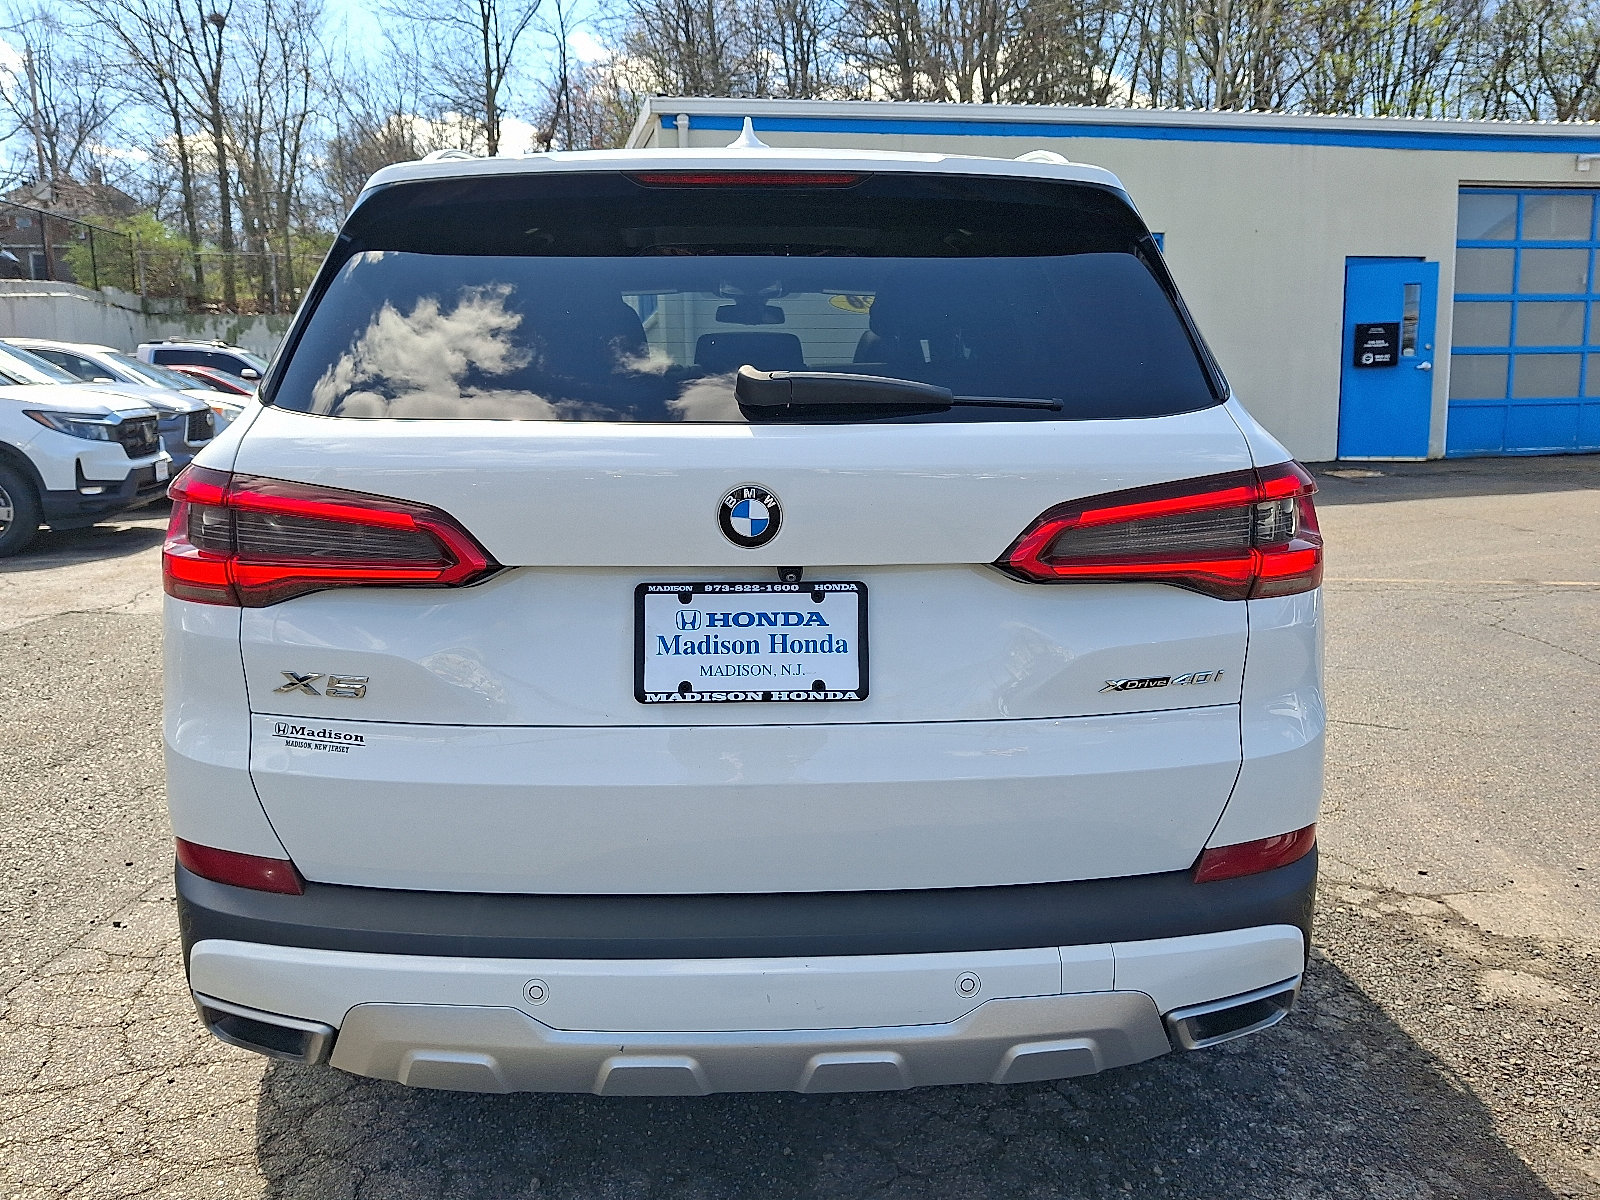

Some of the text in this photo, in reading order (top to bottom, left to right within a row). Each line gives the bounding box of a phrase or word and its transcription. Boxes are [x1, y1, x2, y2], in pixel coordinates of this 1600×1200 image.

[724, 488, 777, 509] BMW
[704, 584, 800, 592] 973-822-1600
[813, 583, 859, 591] HONDA
[705, 611, 830, 628] HONDA
[655, 633, 849, 656] Madison Honda
[699, 663, 806, 678] MADISON, N.J.
[272, 670, 370, 699] X5
[644, 690, 861, 703] MADISON HONDA
[289, 724, 365, 743] Madison
[284, 739, 350, 754] MADISON, NEW JERSEY
